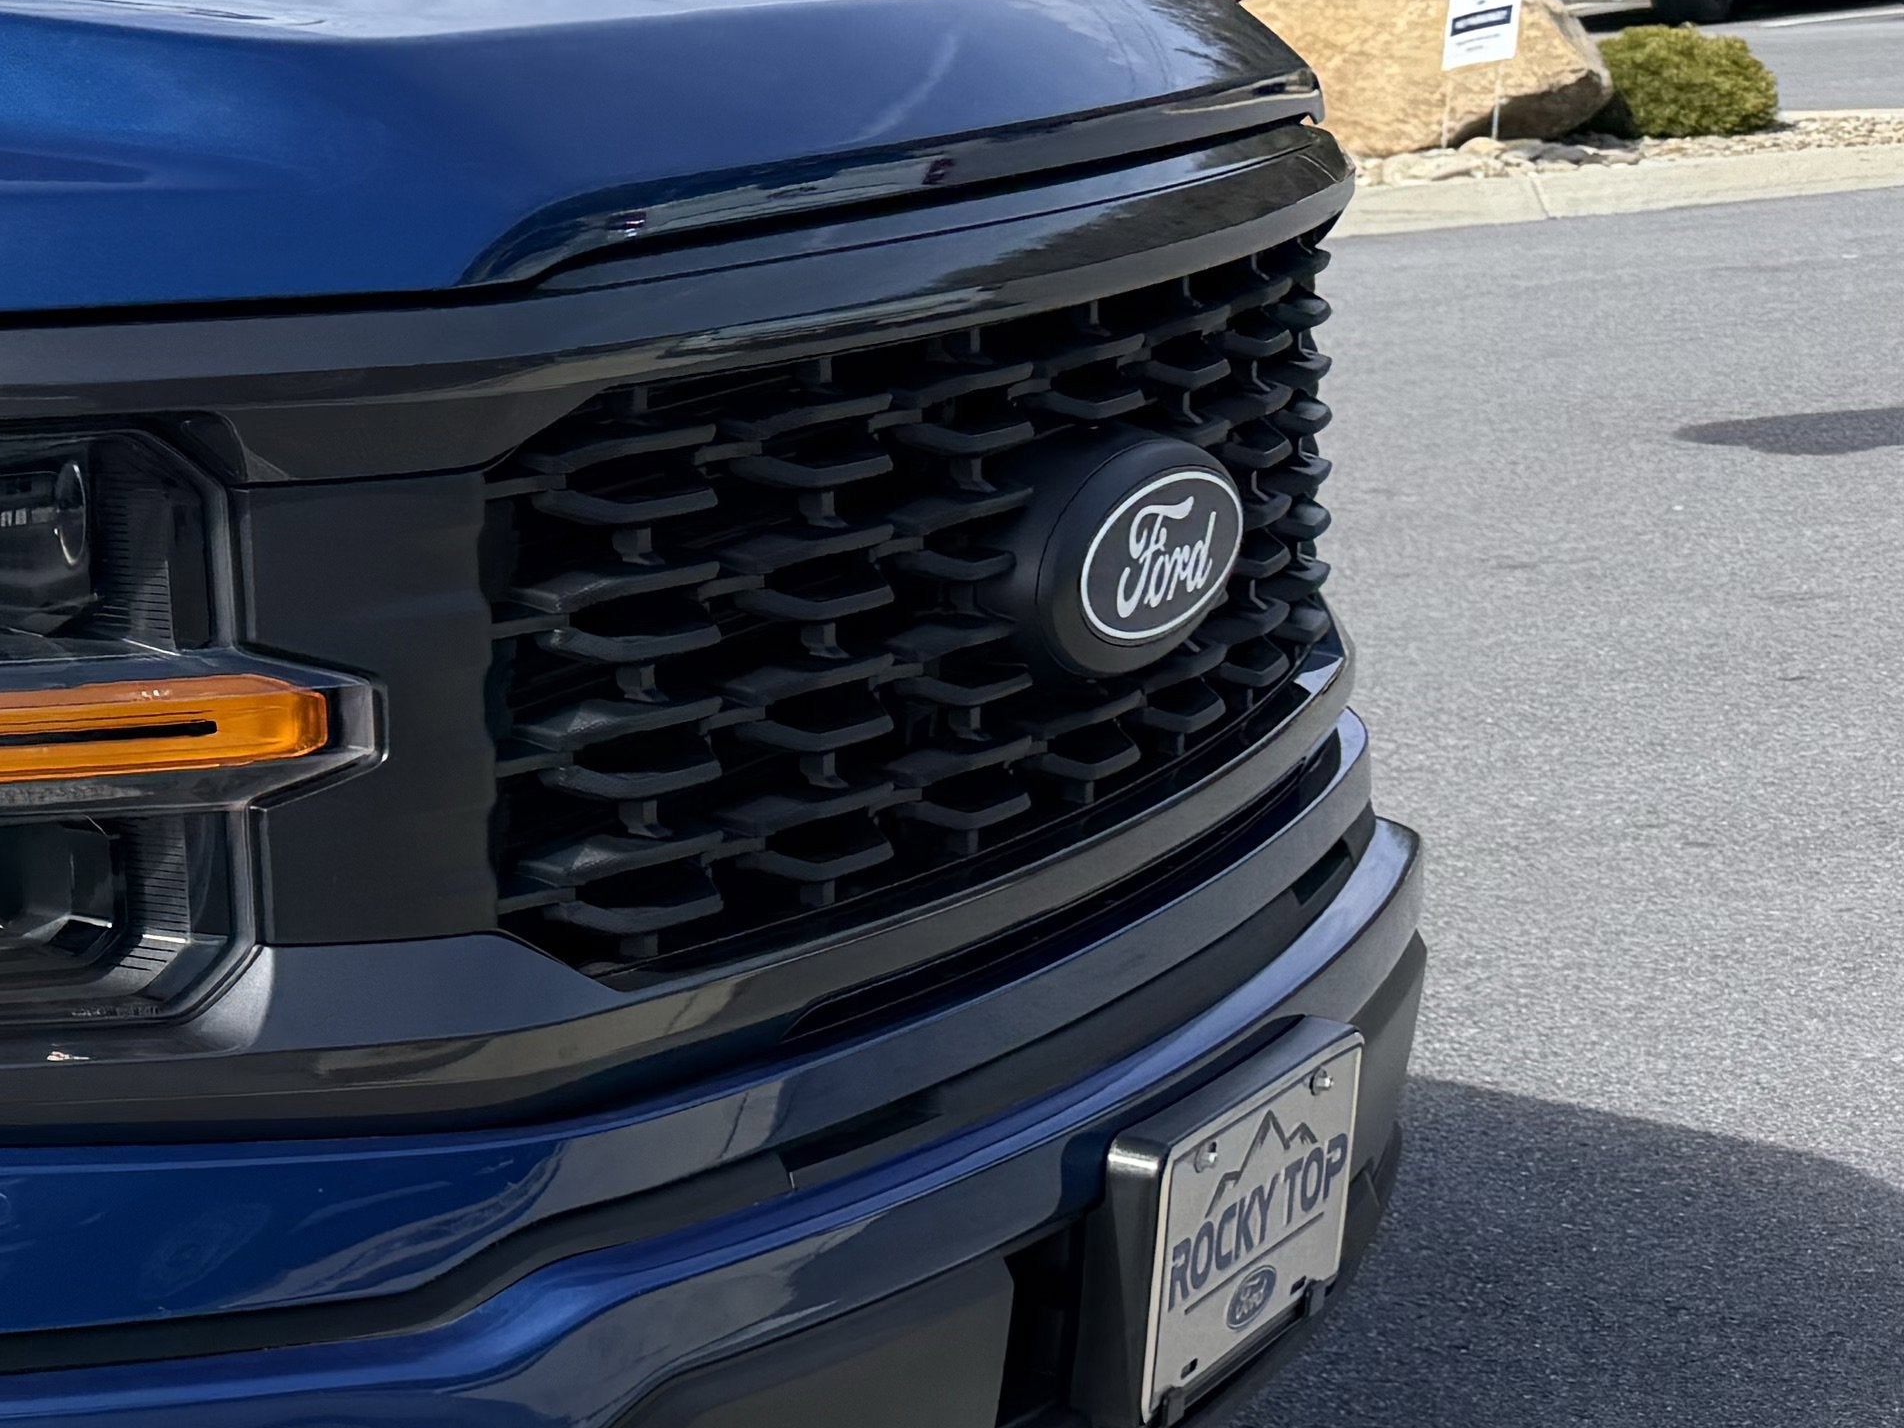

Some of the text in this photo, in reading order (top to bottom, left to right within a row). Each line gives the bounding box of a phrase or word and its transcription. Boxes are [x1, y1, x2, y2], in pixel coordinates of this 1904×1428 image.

[1117, 496, 1216, 618] Ford
[1168, 1133, 1349, 1313] ROCKY TOP
